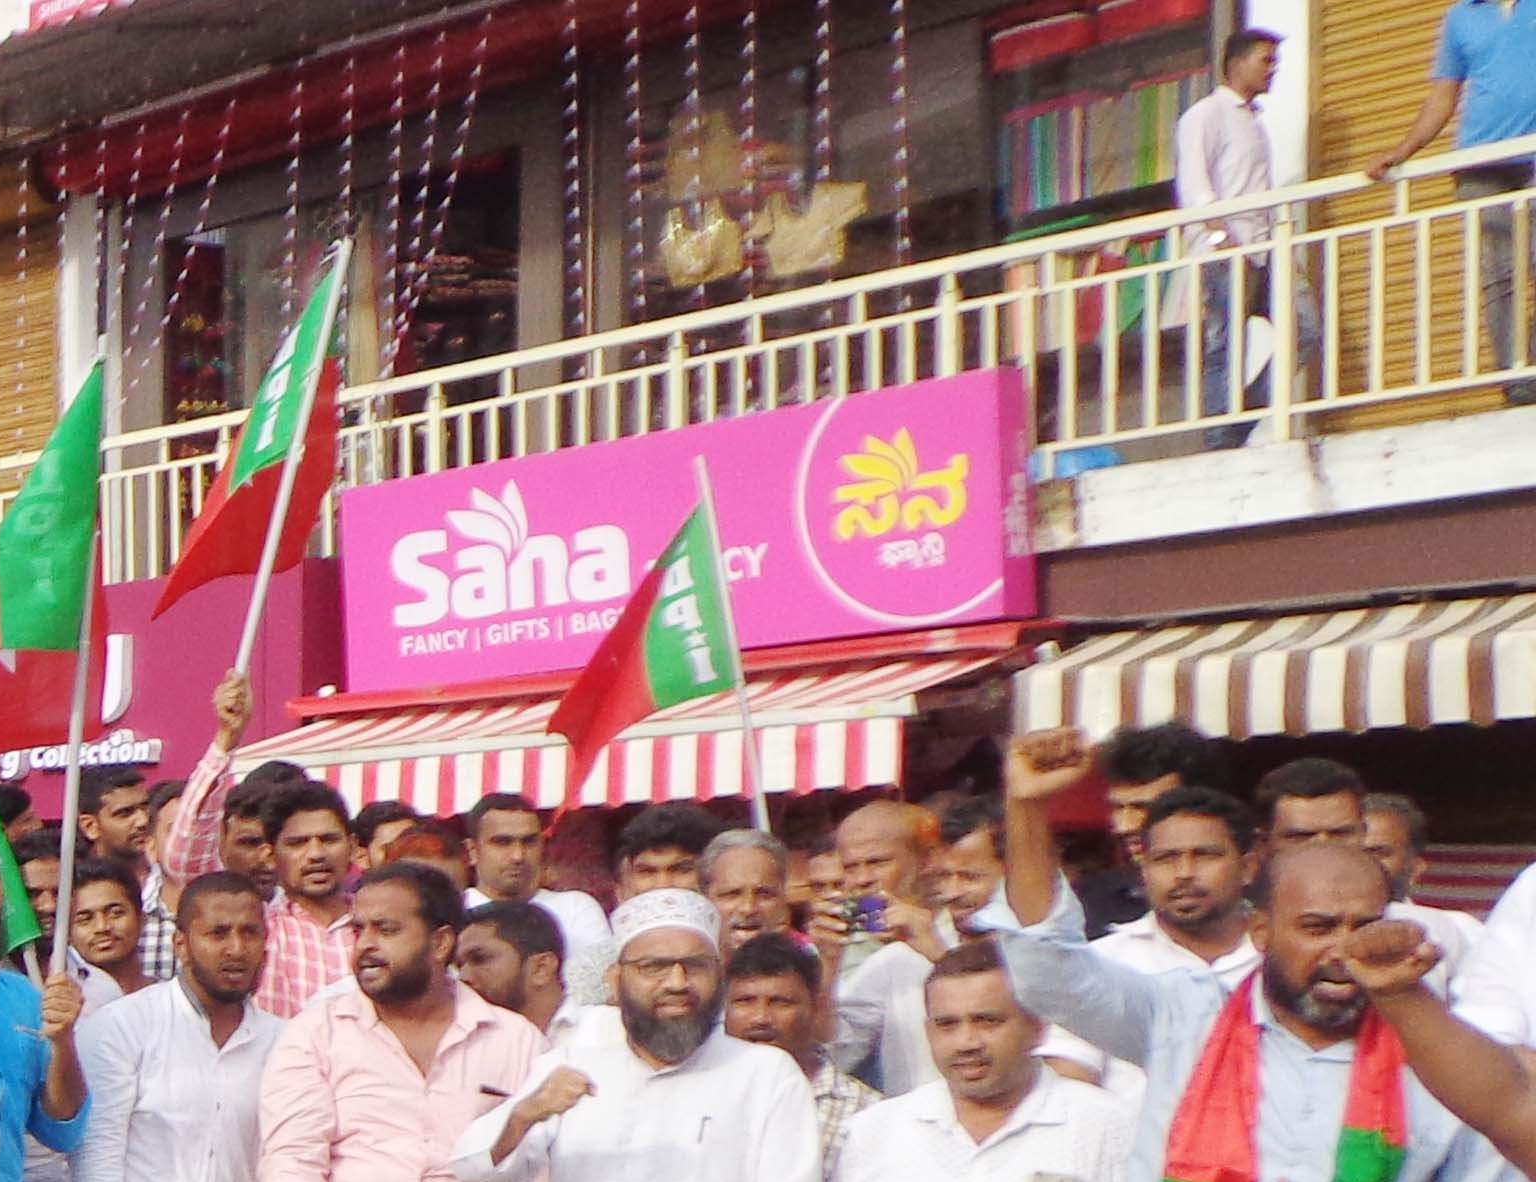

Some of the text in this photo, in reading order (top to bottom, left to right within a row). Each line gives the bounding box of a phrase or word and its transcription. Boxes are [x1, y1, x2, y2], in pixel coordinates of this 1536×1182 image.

[391, 522, 631, 629] Sana
[399, 628, 469, 656] FANCY
[486, 618, 551, 645] GIFTS
